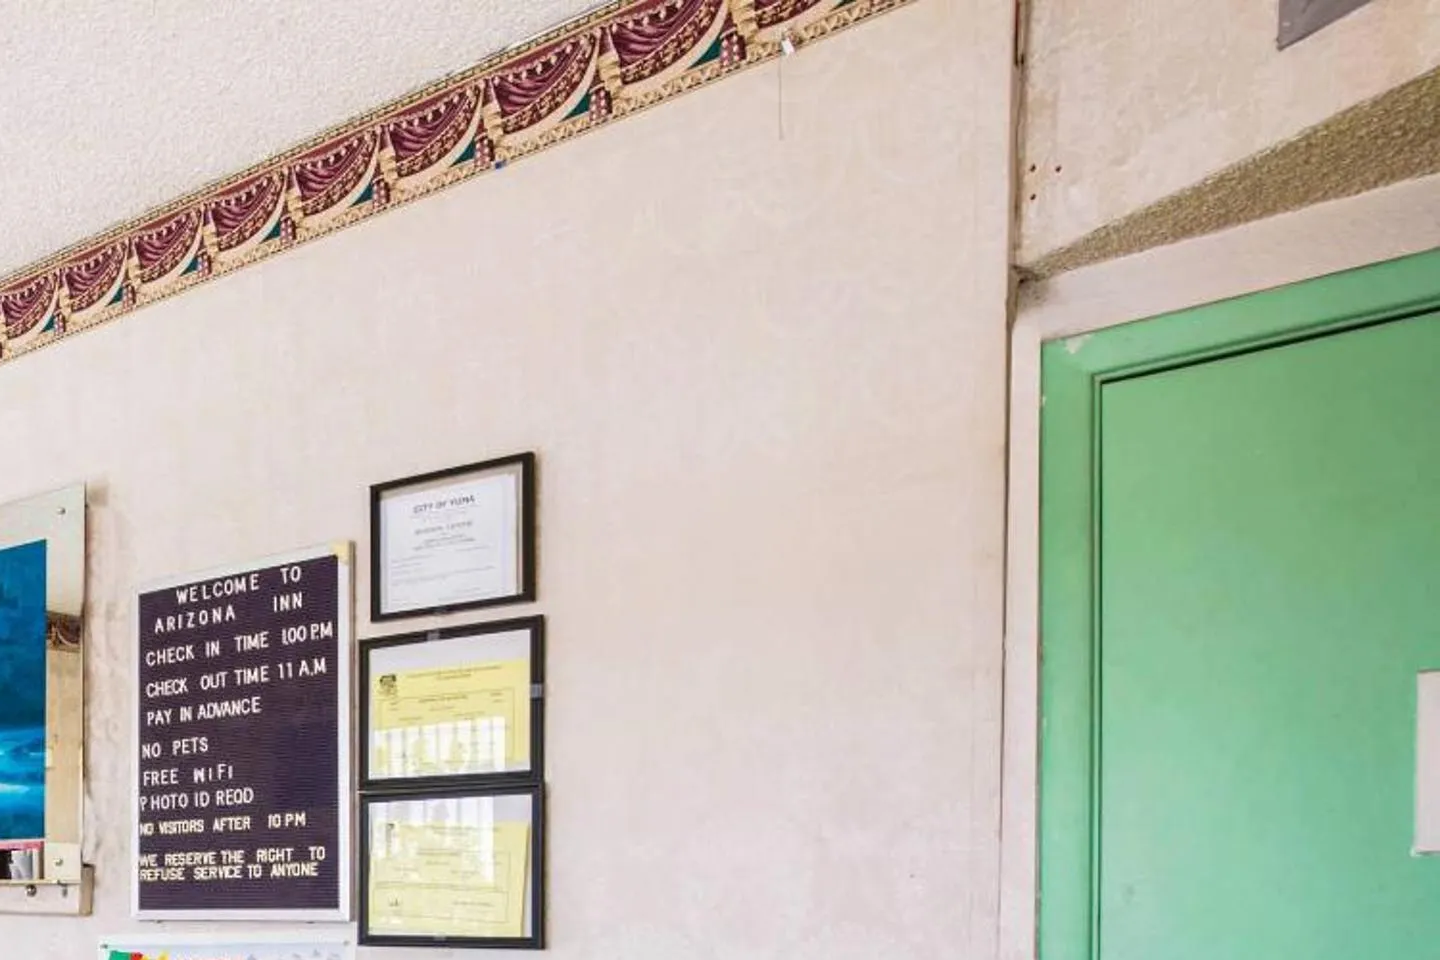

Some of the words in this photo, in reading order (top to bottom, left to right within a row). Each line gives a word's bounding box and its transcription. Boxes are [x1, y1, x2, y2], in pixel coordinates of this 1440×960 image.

[176, 574, 259, 604] WELCOME
[280, 566, 301, 584] TO
[155, 605, 235, 633] ARIZONA
[274, 592, 302, 612] INN
[146, 645, 194, 666] CHECK
[206, 641, 219, 657] IN
[234, 632, 268, 651] TIME
[146, 678, 188, 697] CHECK
[200, 672, 227, 690] OUT
[234, 666, 269, 685] TIME
[278, 662, 292, 678] 11
[147, 709, 171, 725] PAY
[180, 706, 192, 722] IN
[198, 697, 261, 719] ADVANCE
[142, 743, 161, 758] NO
[173, 737, 208, 755] PETS
[144, 768, 178, 786] FREE
[140, 793, 188, 811] PHOTO
[195, 791, 210, 807] ID
[140, 823, 154, 835] NO
[213, 816, 250, 831] AFTER
[285, 812, 306, 826] PM
[140, 854, 157, 867] WE
[221, 850, 244, 864] THE
[257, 848, 293, 862] RIGHT
[309, 846, 325, 860] TO
[140, 868, 185, 880] REFUSE
[194, 866, 242, 879] SERVICE
[247, 865, 262, 879] TO
[270, 862, 318, 878] ANYONE
